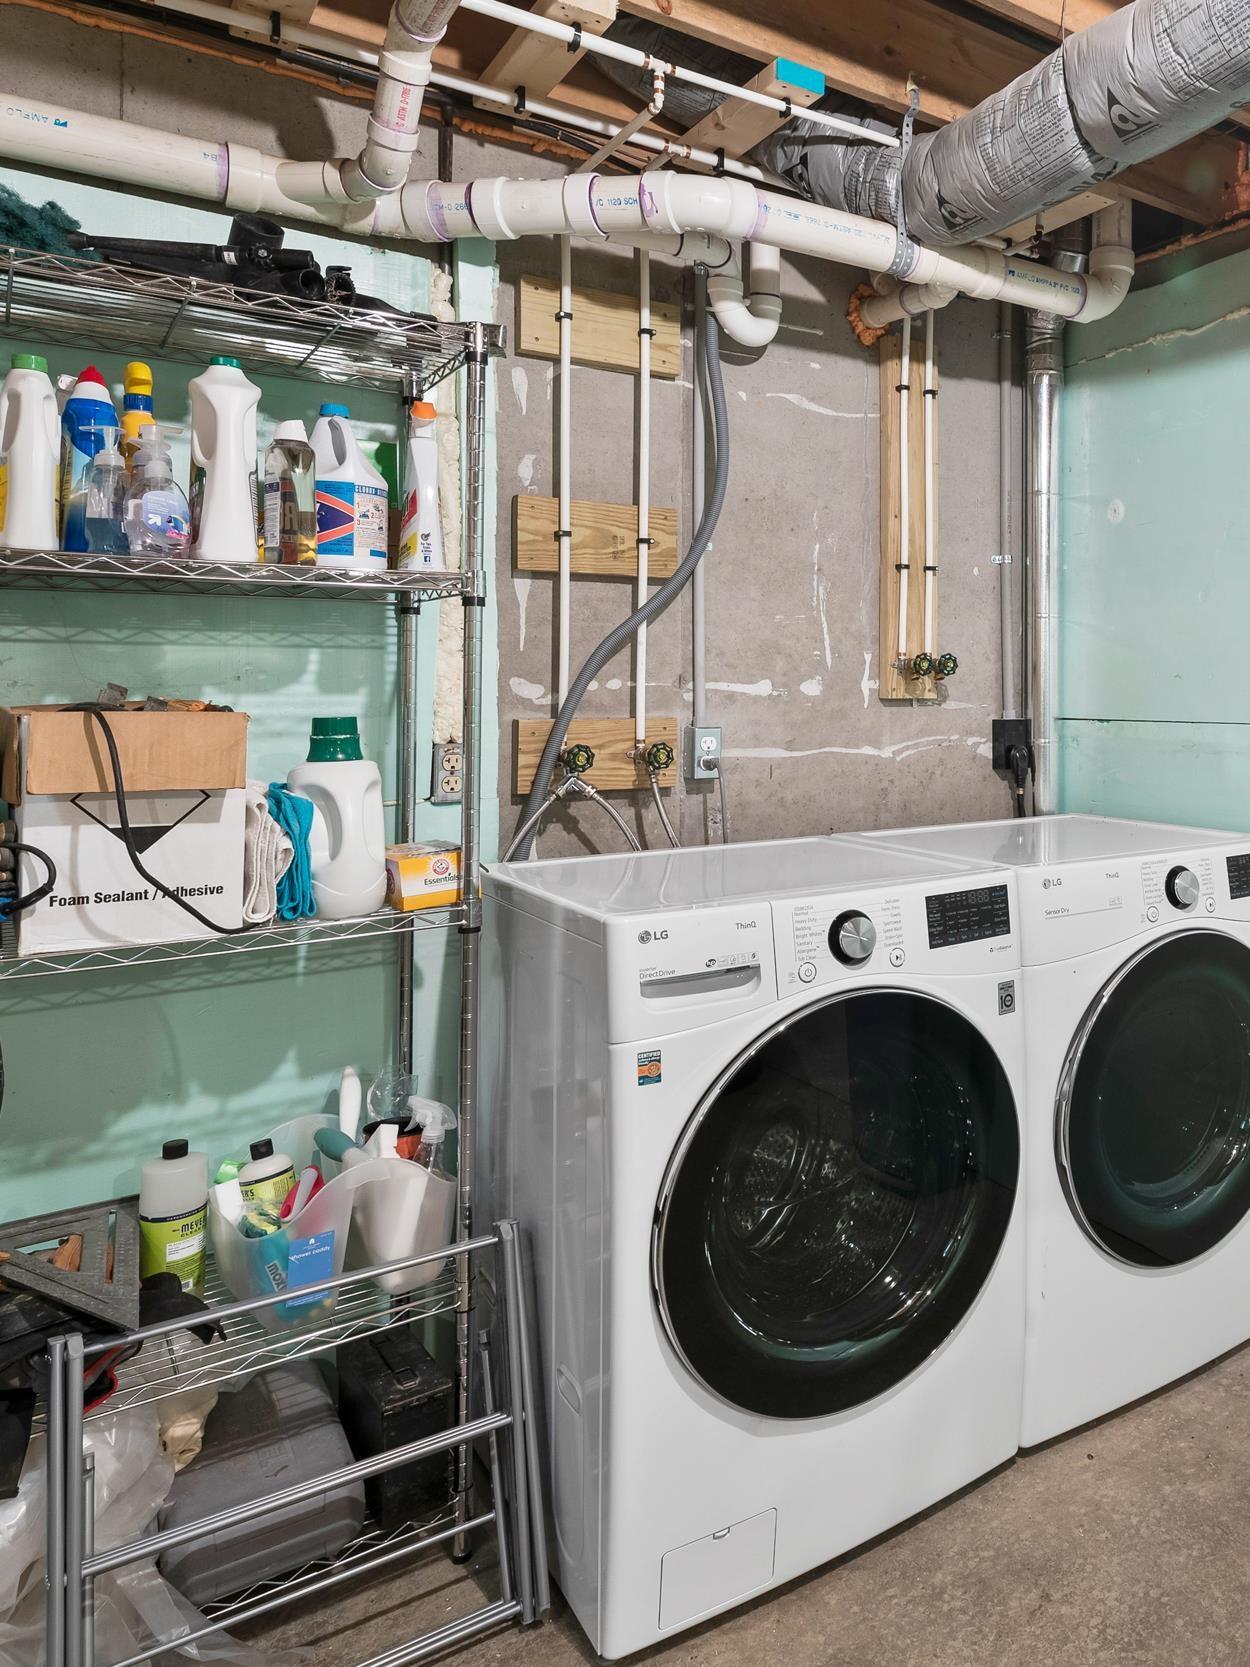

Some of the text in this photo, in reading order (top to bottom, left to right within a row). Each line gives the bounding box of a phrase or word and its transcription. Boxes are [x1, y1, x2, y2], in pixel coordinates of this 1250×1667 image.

[424, 872, 460, 886] Essentials
[1052, 878, 1063, 887] LG
[49, 895, 90, 907] Foam
[94, 888, 149, 904] Sealant
[735, 921, 757, 930] ThinQ
[653, 930, 669, 941] LG
